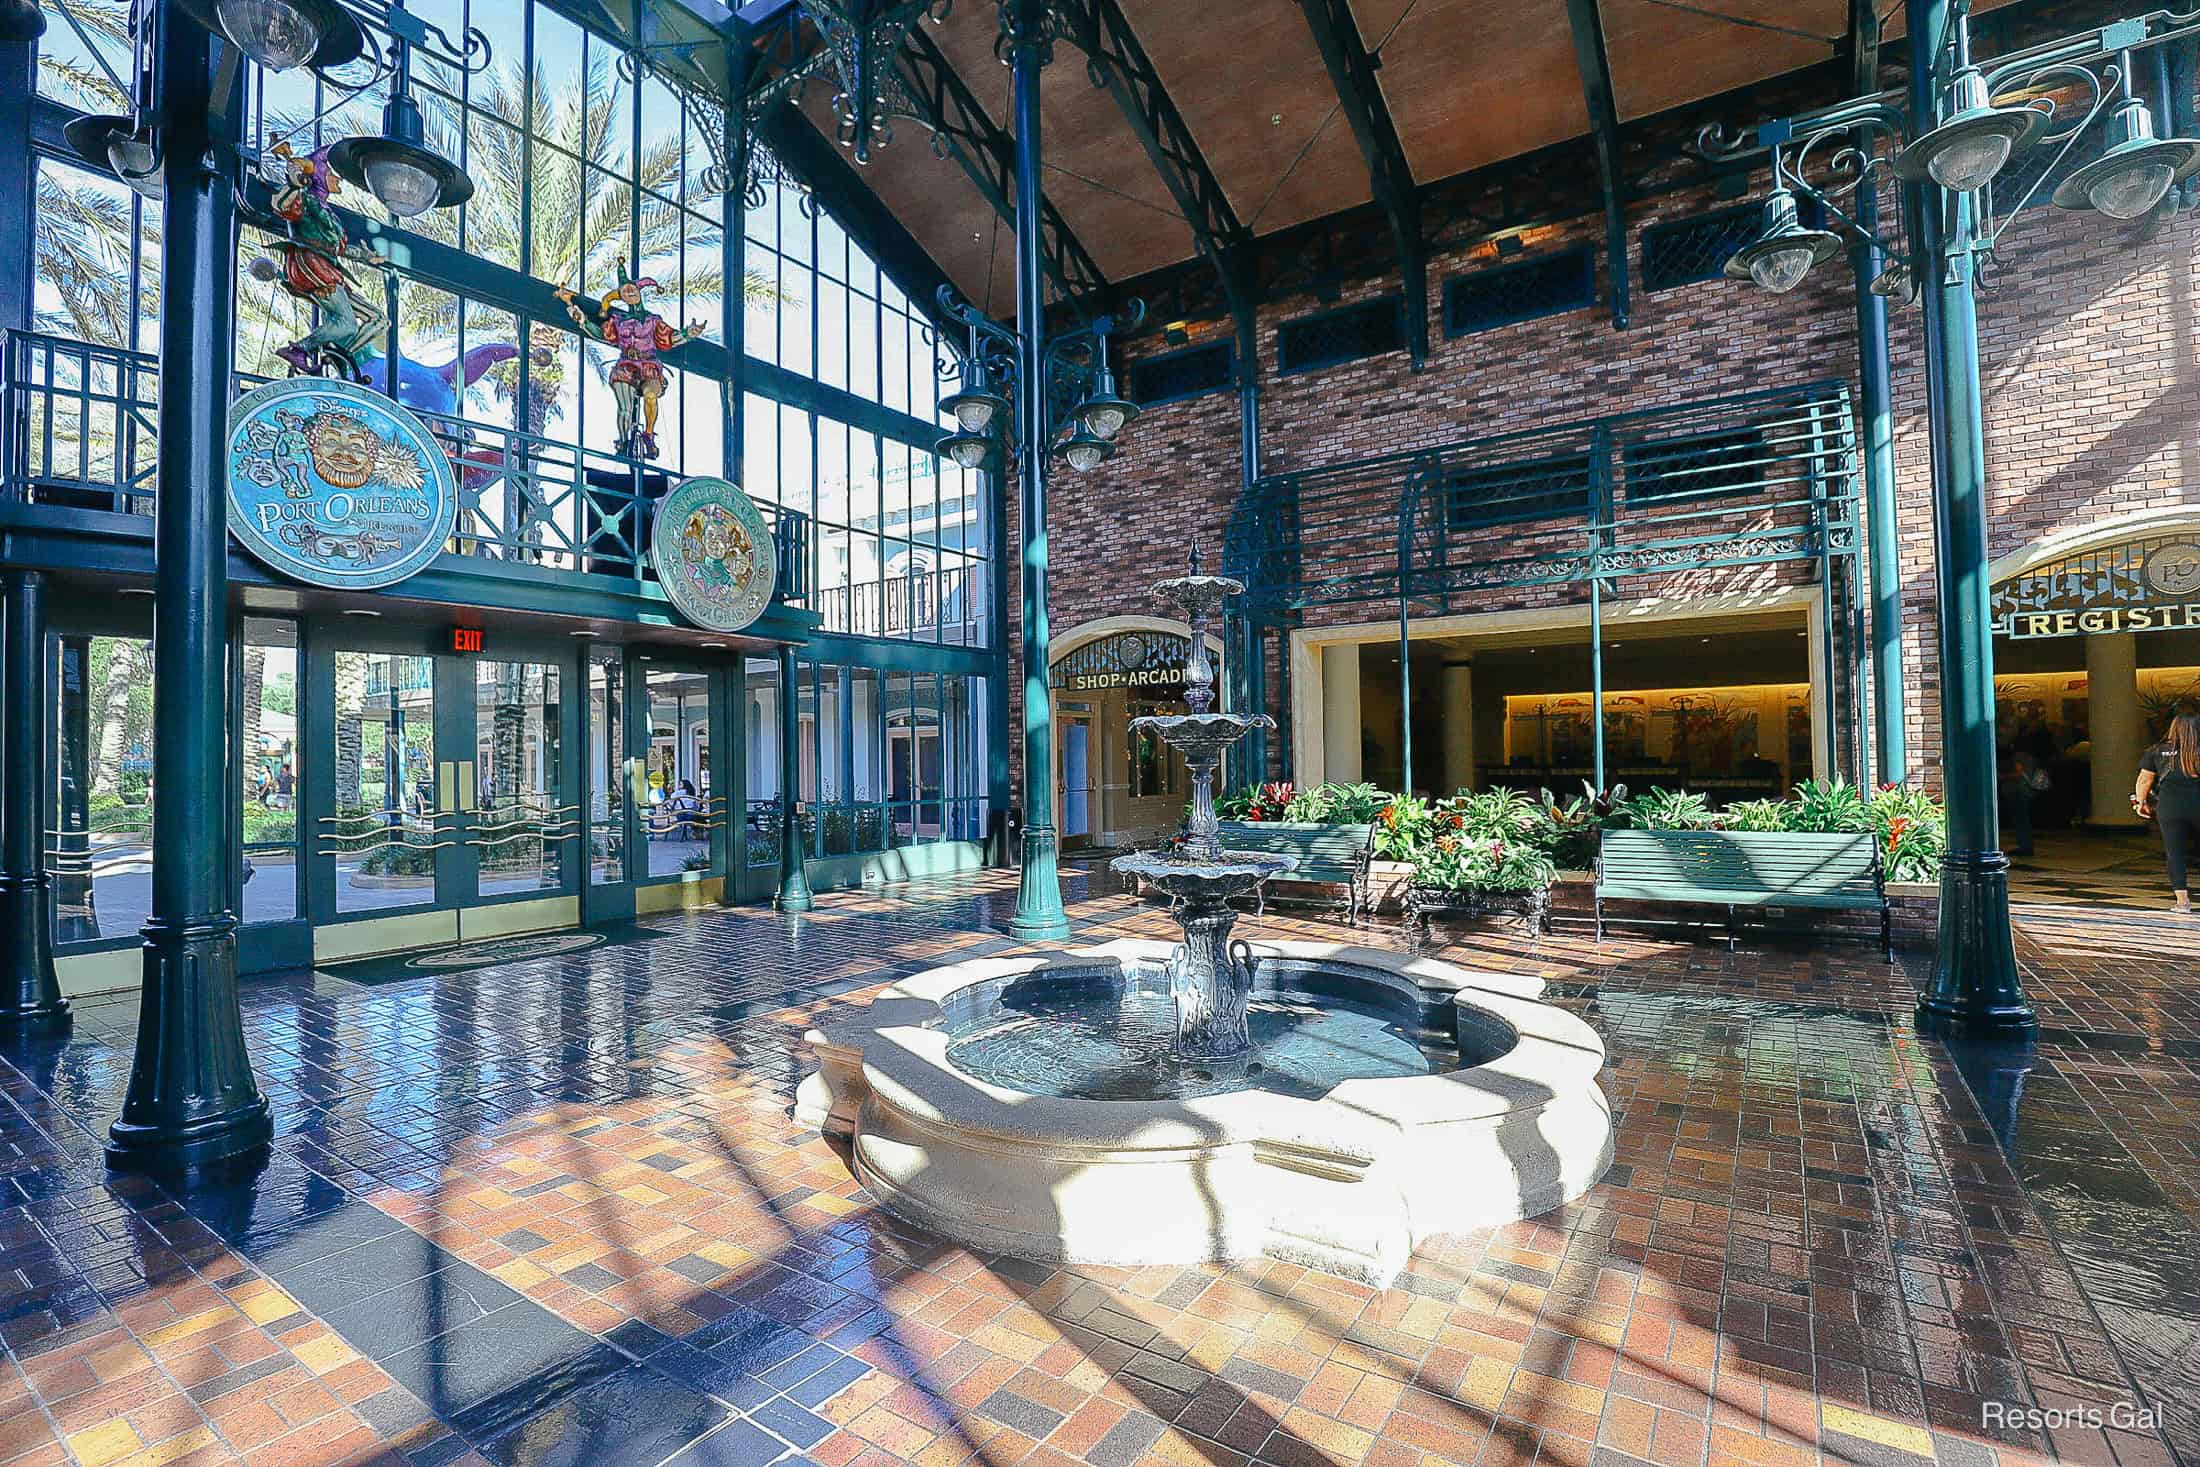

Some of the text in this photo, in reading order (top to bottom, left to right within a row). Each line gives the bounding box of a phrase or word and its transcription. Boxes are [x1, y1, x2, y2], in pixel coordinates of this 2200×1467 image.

[256, 501, 321, 533] PORT
[325, 493, 431, 522] ORLEANS
[454, 628, 485, 652] EXIT
